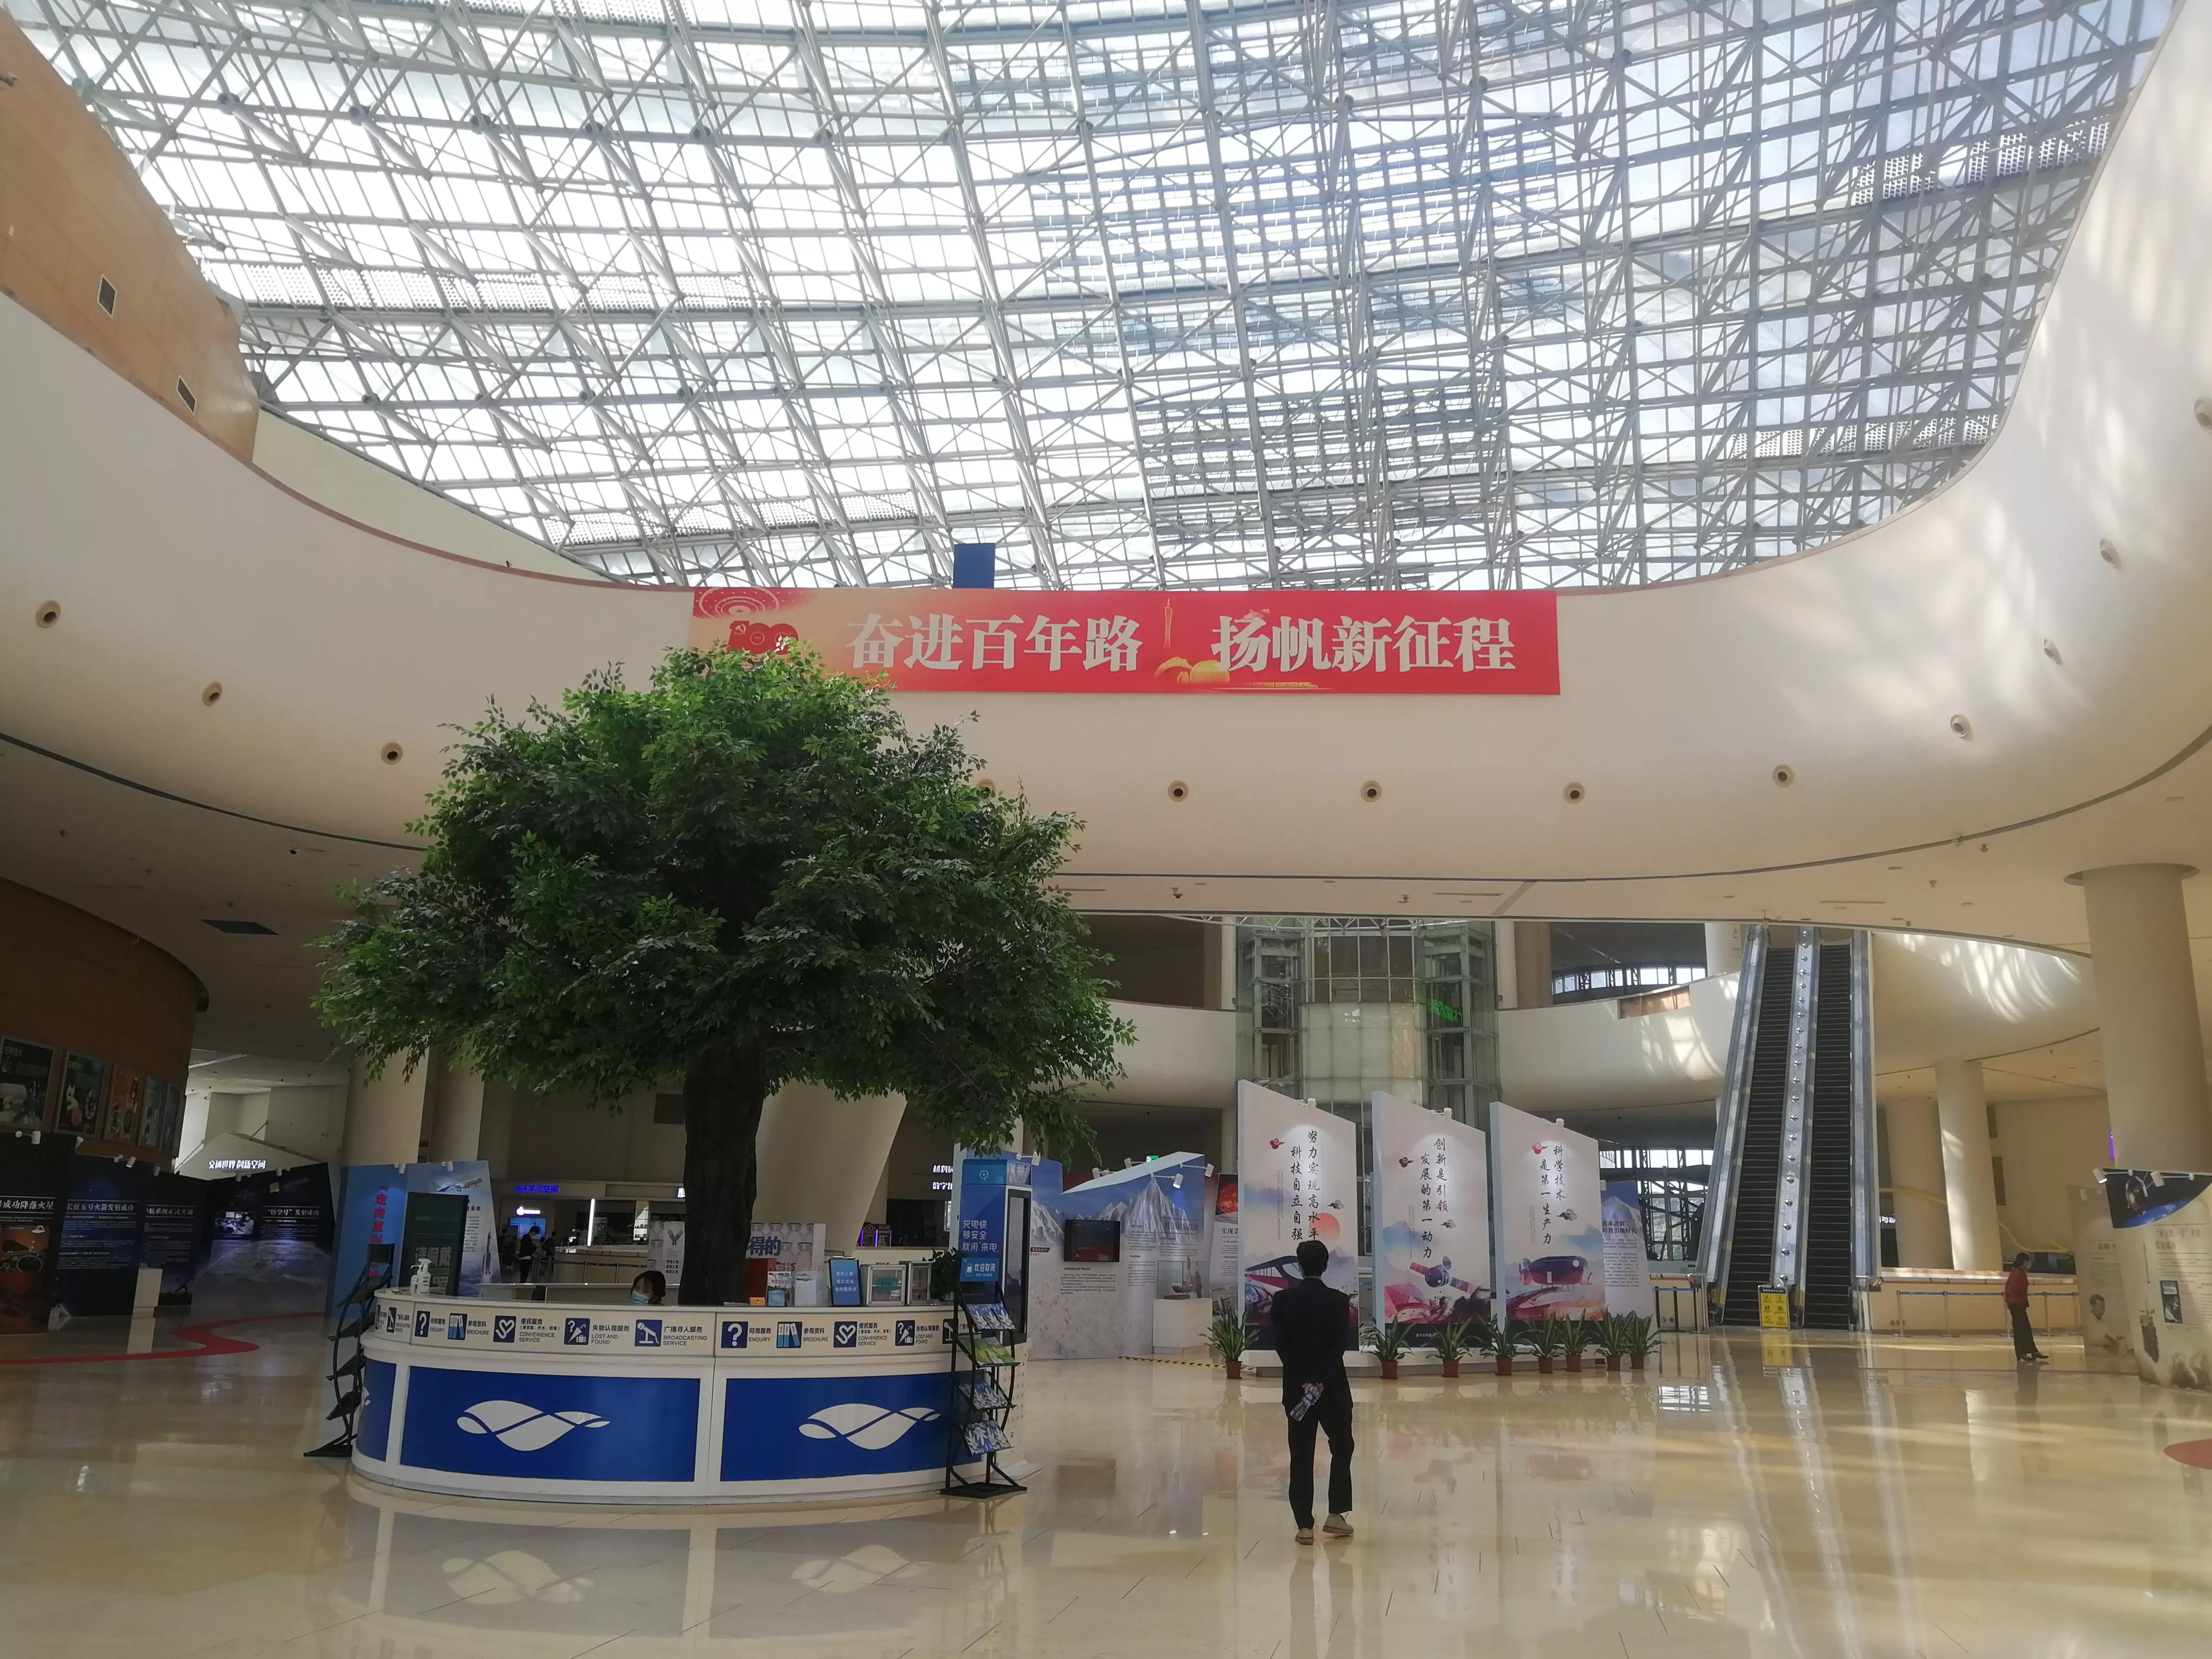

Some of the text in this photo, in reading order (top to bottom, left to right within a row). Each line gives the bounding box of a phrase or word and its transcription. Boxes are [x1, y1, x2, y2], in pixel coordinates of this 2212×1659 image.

[848, 613, 1518, 673] 奋进百年路 扬帆新征程
[1290, 1145, 1303, 1241] 科技自立自强
[1307, 1129, 1321, 1241] 努力实现高水平
[1419, 1152, 1433, 1259] 发展的第一动力
[1434, 1138, 1449, 1213] 创新是引领
[1539, 1158, 1552, 1245] 是第一生产力
[1552, 1144, 1566, 1202] 科学技术
[962, 1220, 987, 1229] 充电快
[962, 1230, 987, 1240] 够安全
